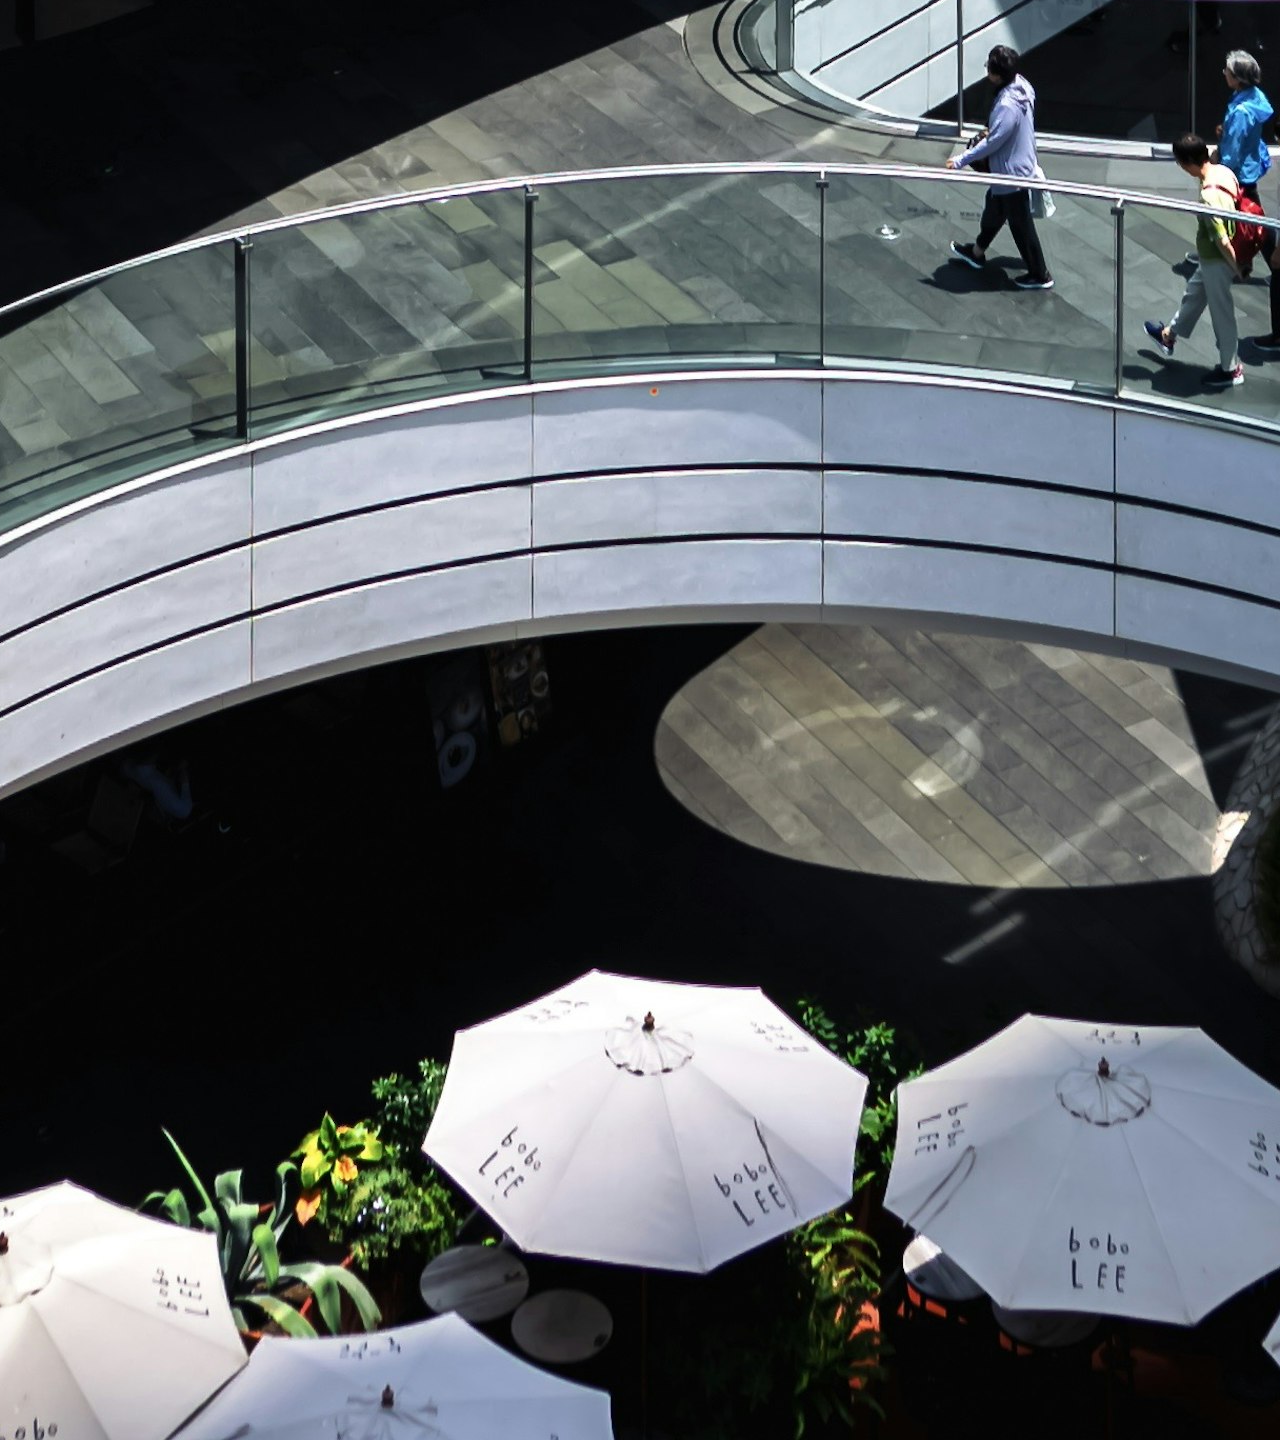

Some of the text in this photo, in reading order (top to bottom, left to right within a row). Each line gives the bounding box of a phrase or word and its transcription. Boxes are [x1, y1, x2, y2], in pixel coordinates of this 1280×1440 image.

[915, 1112, 942, 1156] LEE
[947, 1102, 969, 1148] bobo
[500, 1126, 542, 1172] bobo
[1247, 1131, 1270, 1178] bobo
[477, 1150, 525, 1199] LEE
[713, 1162, 767, 1198] bobo
[732, 1183, 787, 1228] LEE
[1068, 1225, 1130, 1256] bobo
[176, 1275, 210, 1316] LEE
[1071, 1259, 1126, 1294] LEE
